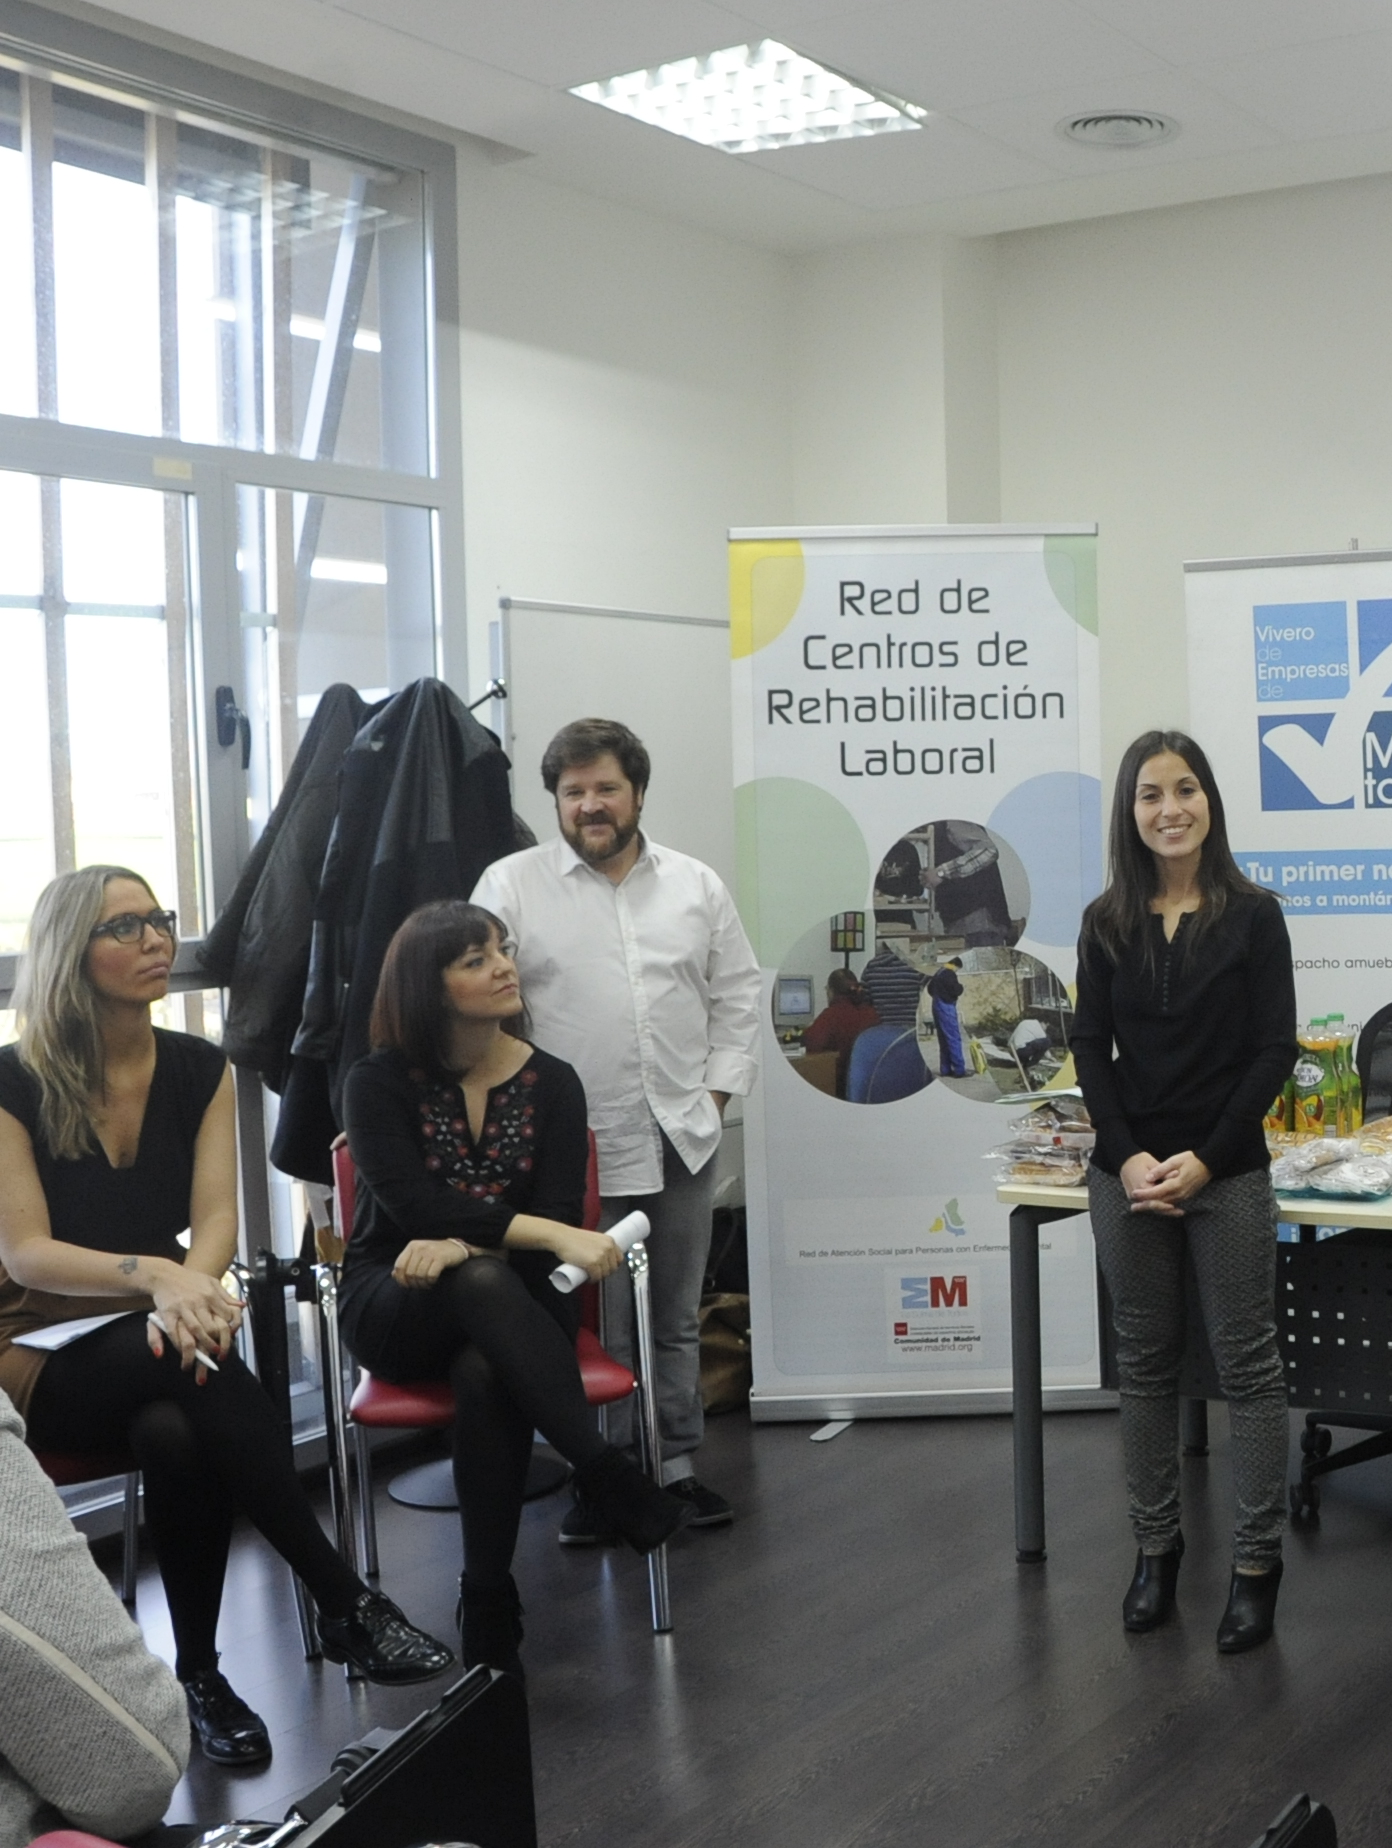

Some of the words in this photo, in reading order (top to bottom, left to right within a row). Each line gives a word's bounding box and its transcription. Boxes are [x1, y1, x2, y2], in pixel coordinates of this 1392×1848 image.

[839, 579, 919, 616] Red
[939, 578, 990, 615] de
[1256, 625, 1315, 643] Vivero
[803, 633, 960, 670] Centros
[977, 631, 1028, 667] de
[1257, 645, 1282, 661] de
[1258, 662, 1349, 682] Empresas
[1259, 683, 1283, 699] de
[767, 684, 1065, 725] Rehabilitación
[839, 738, 995, 777] Laboral
[1240, 861, 1273, 883] Tu
[1282, 861, 1365, 887] primer
[1316, 895, 1328, 907] a
[1292, 957, 1340, 972] pacho
[800, 1250, 816, 1259] Red
[818, 1249, 829, 1258] de
[831, 1248, 866, 1258] Atención
[868, 1247, 892, 1256] Social
[895, 1248, 913, 1257] para
[916, 1246, 954, 1255] Personas
[901, 1343, 974, 1353] www.madrid.org
